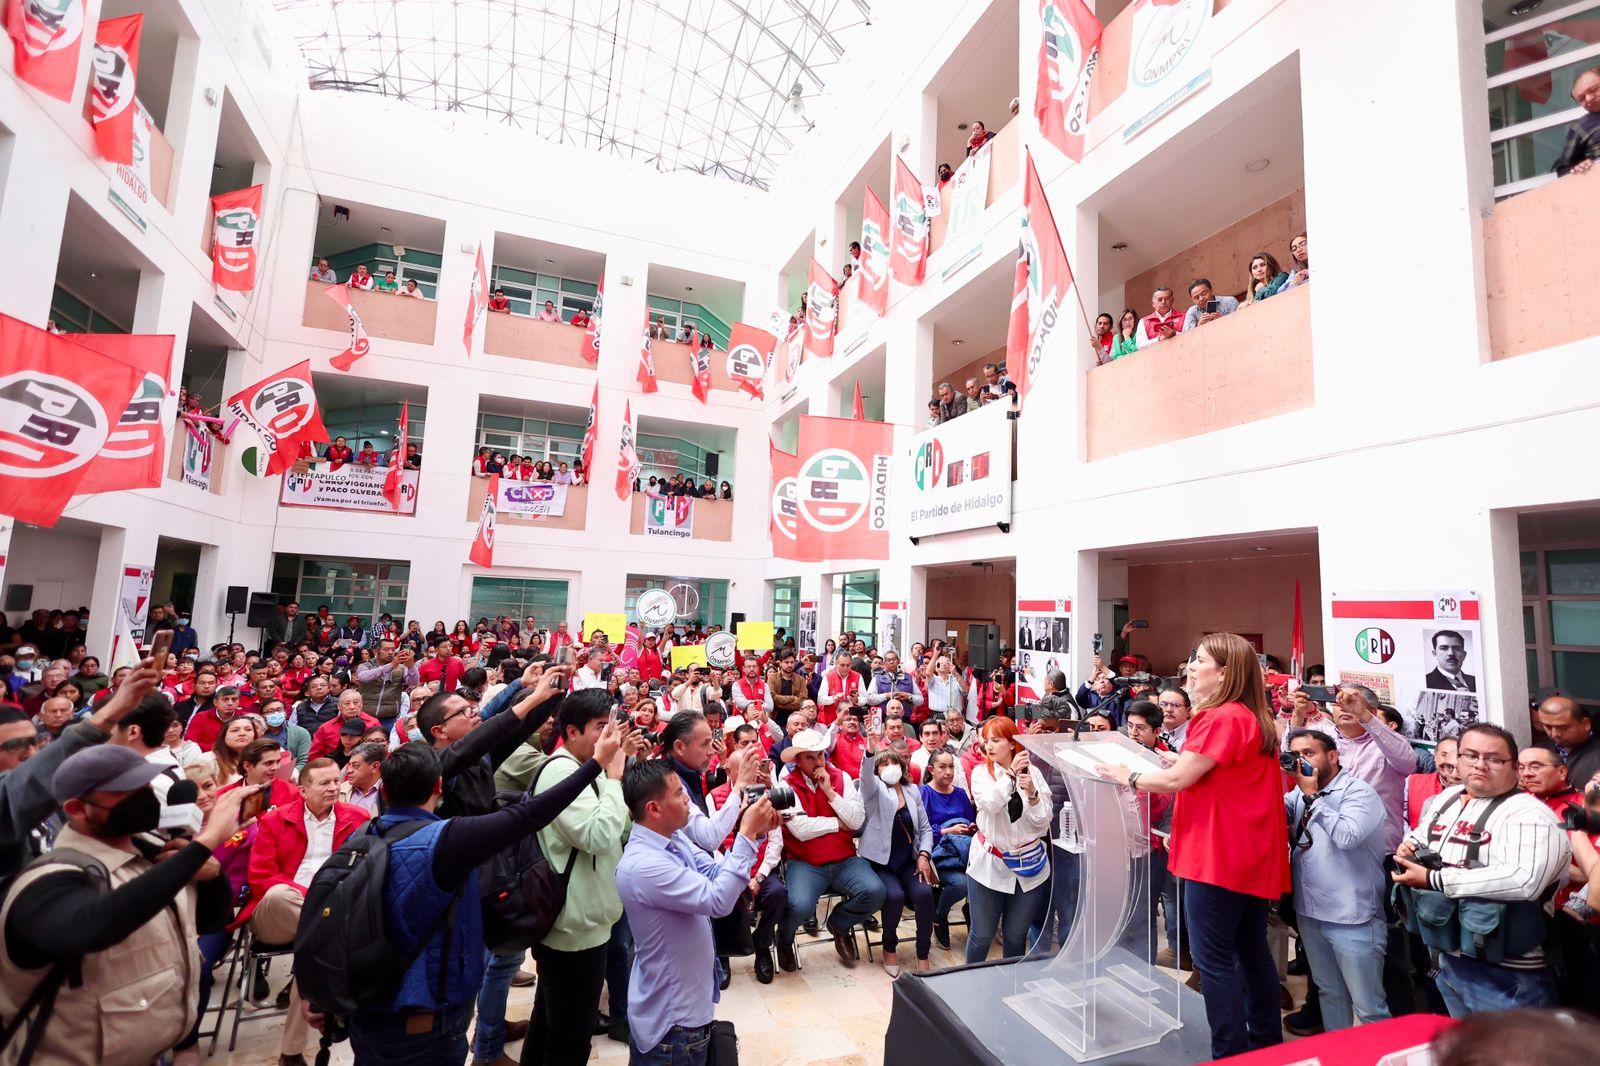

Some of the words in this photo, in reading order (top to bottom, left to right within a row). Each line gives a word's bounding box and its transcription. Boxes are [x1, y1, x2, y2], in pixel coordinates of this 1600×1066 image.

[116, 163, 148, 204] HIDALGO
[263, 382, 301, 429] PRI
[916, 440, 942, 485] PRI
[350, 488, 382, 496] OLVERA
[910, 511, 918, 522] El
[919, 505, 949, 521] Partido
[951, 502, 962, 514] de
[964, 493, 1004, 511] Hidalgo
[647, 527, 691, 538] Tulancingo
[1359, 637, 1392, 655] PRM
